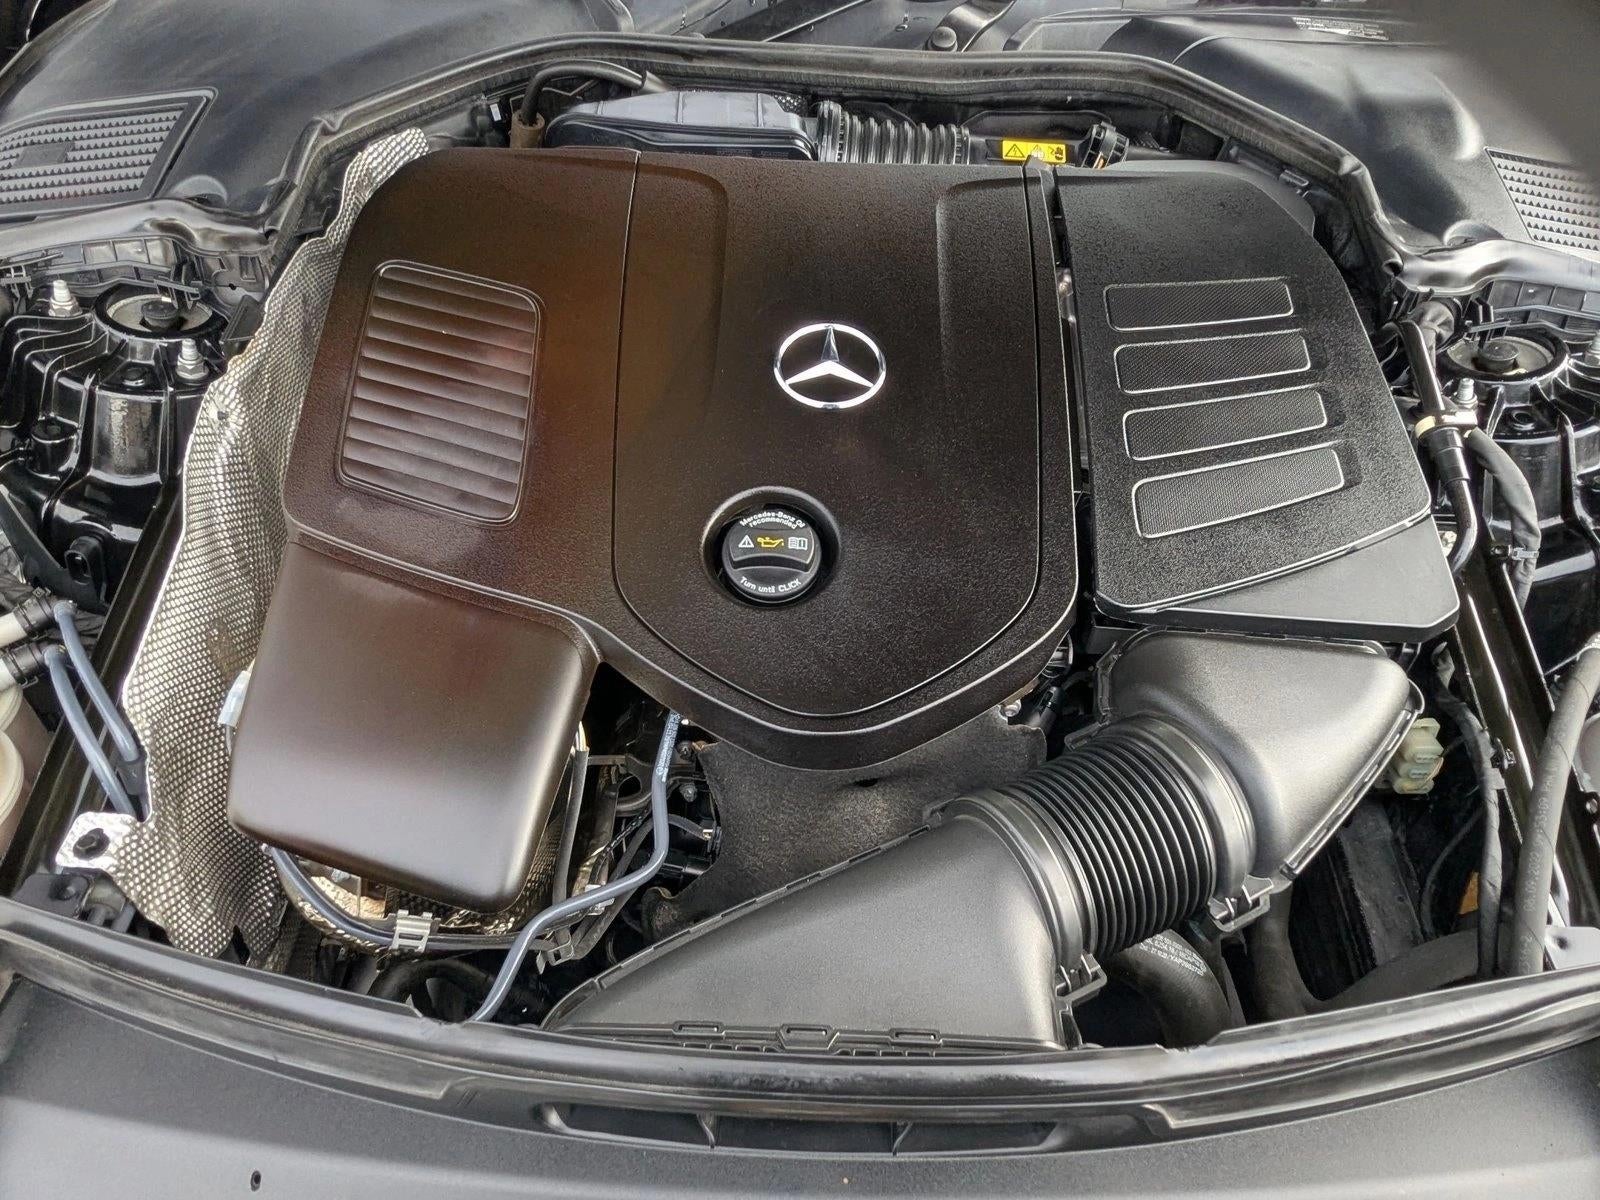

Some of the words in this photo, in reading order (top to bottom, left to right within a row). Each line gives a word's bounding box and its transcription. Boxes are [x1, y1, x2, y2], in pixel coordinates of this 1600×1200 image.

[739, 511, 796, 527] Mercedes-Benz
[796, 519, 806, 529] Oil
[749, 516, 798, 530] recommended
[739, 576, 757, 590] Turn
[758, 585, 776, 593] until
[778, 578, 802, 592] CLICK
